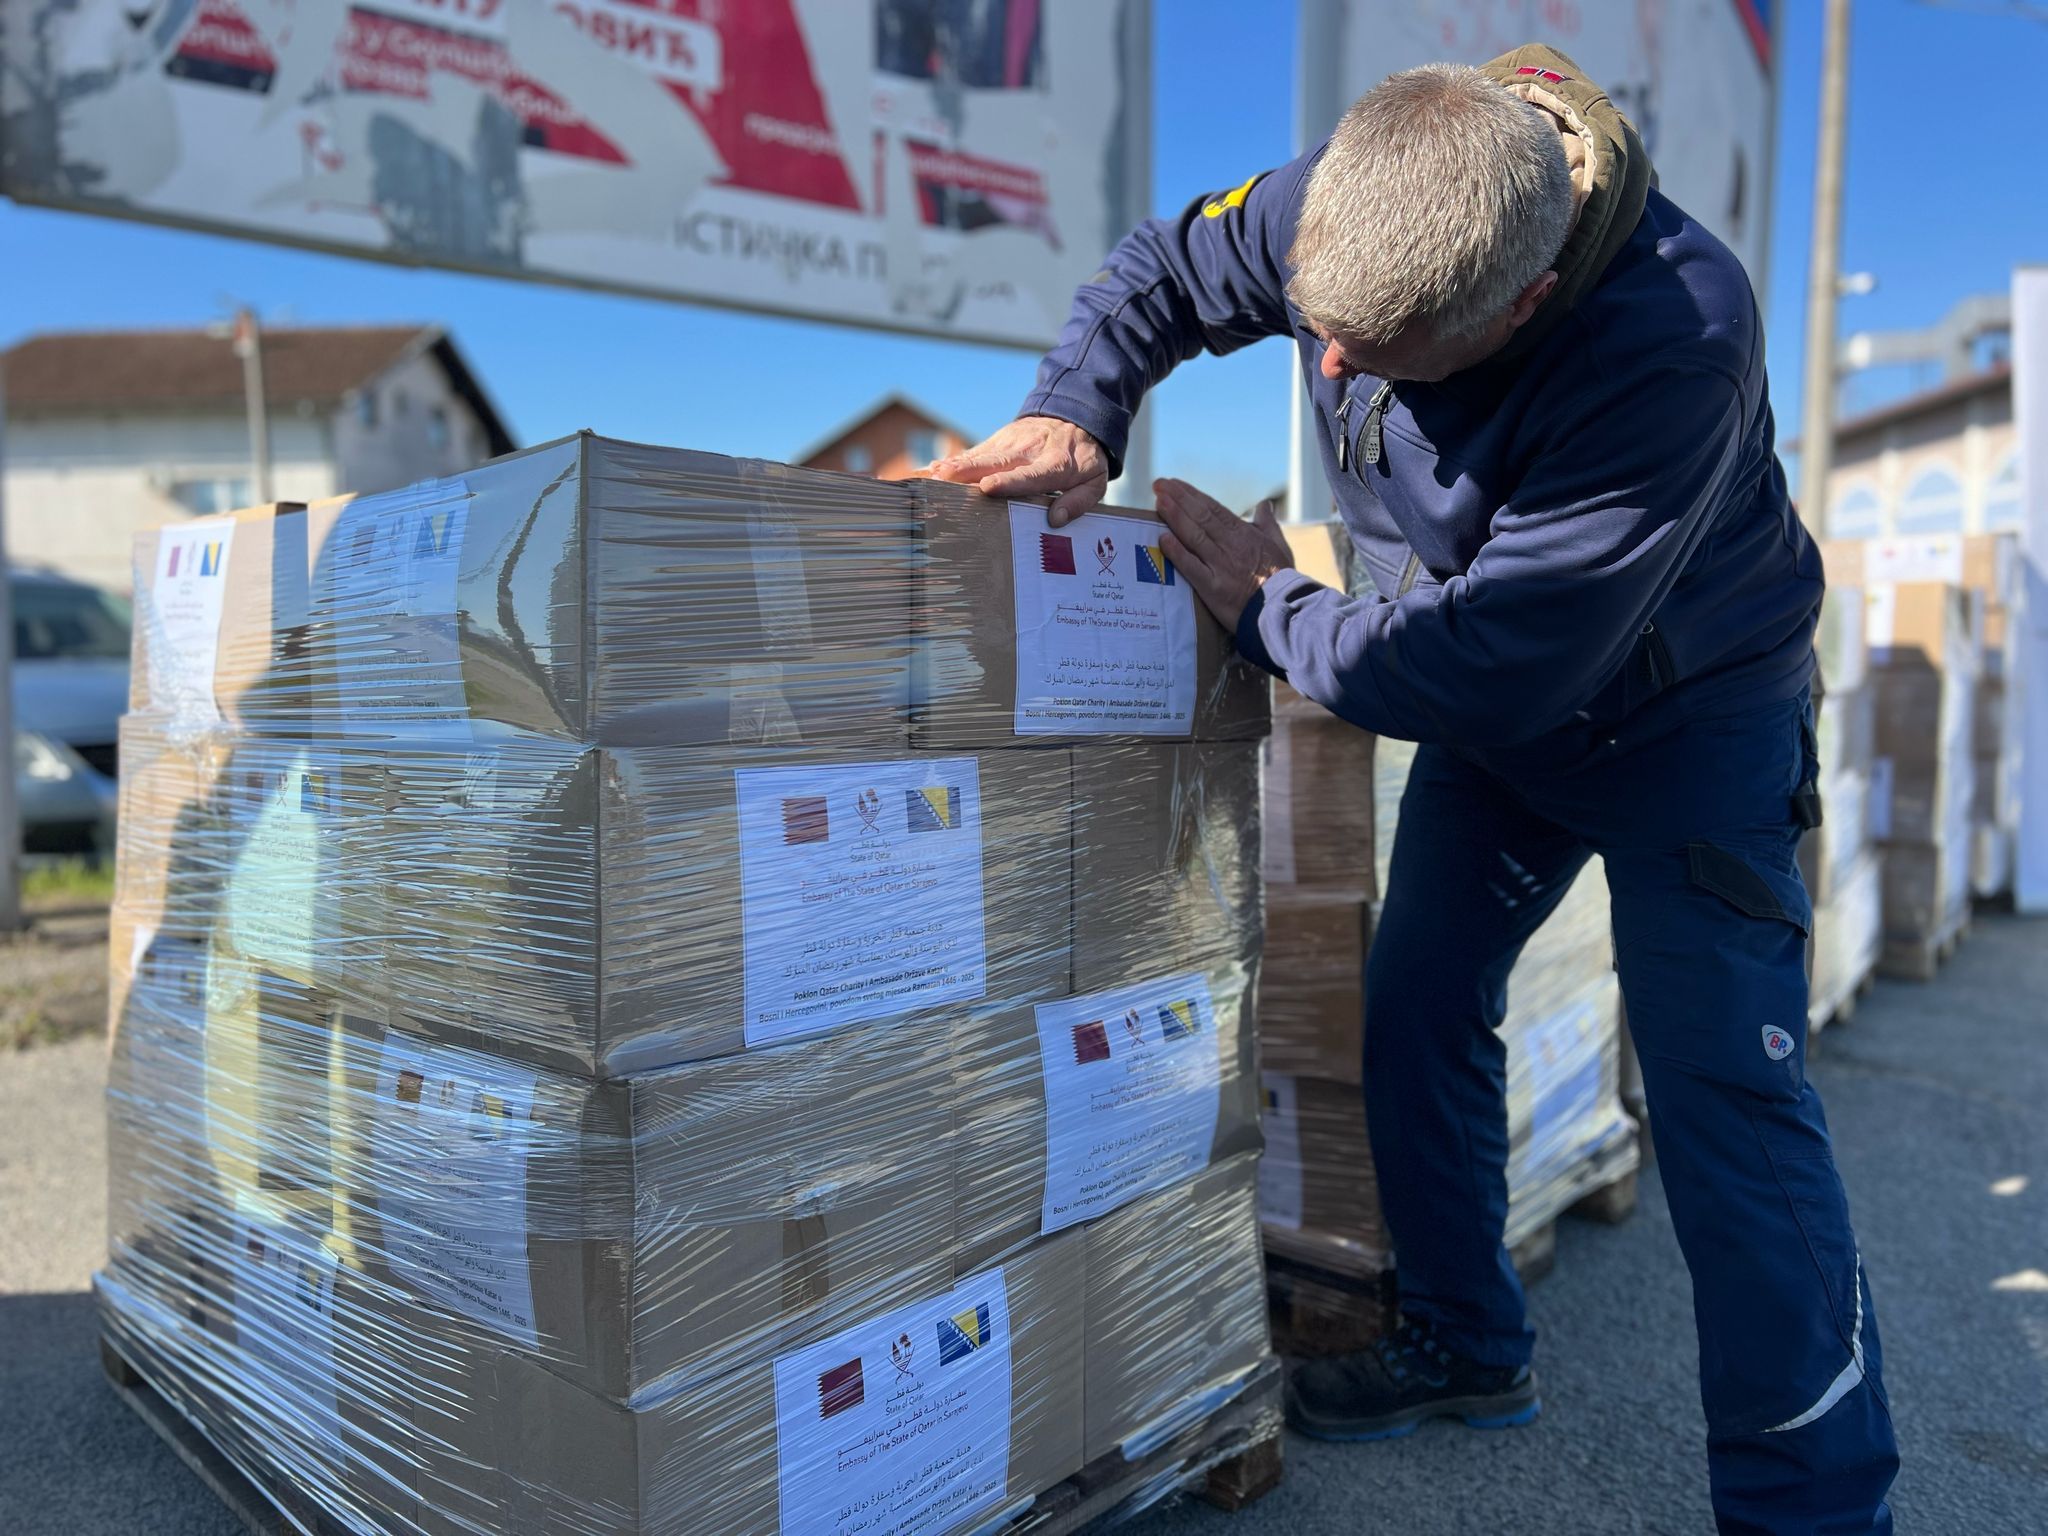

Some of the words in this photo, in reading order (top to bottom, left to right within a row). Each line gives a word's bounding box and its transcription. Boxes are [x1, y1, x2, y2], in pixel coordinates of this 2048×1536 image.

[1105, 591, 1110, 599] of
[1111, 592, 1124, 600] Qatar
[1057, 615, 1080, 627] Embassy
[1081, 617, 1087, 625] of
[1089, 617, 1097, 626] The
[1098, 619, 1112, 627] State
[1113, 618, 1118, 627] of
[1120, 620, 1135, 630] Qatar
[1088, 699, 1105, 707] Charity
[850, 854, 866, 863] State
[867, 852, 874, 860] of
[874, 851, 891, 861] Qatar
[802, 890, 833, 903] Embassy
[834, 887, 842, 896] of
[856, 886, 875, 896] State
[876, 883, 883, 893] of
[884, 882, 902, 893] Qatar
[794, 990, 818, 1000] Poklon
[820, 986, 839, 996] Qatar
[841, 981, 864, 992] Charity
[870, 975, 903, 986] Ambasade
[759, 1010, 779, 1023] Bosni
[785, 1002, 828, 1018] Hercegovini,
[829, 996, 862, 1010] povodom
[862, 992, 884, 1001] svetog
[885, 985, 911, 997] mjeseca
[912, 981, 940, 992] Ramazan
[961, 972, 974, 982] 2025
[1080, 1184, 1098, 1194] Poklon
[1053, 1205, 1068, 1214] Bosni
[886, 1405, 900, 1416] State
[902, 1400, 908, 1409] of
[909, 1394, 924, 1405] Qatar
[838, 1452, 868, 1472] Embassy
[869, 1446, 876, 1458] of
[878, 1440, 891, 1452] The
[891, 1432, 909, 1447] State
[910, 1426, 917, 1437] of
[918, 1418, 936, 1434] Qatar
[936, 1415, 942, 1425] in
[943, 1404, 968, 1420] Sarajevo
[934, 1456, 954, 1471] جمعية
[983, 1480, 997, 1493] 2025
[900, 1508, 930, 1529] Ambasade
[952, 1486, 968, 1500] Katar
[835, 1506, 851, 1527] قطر
